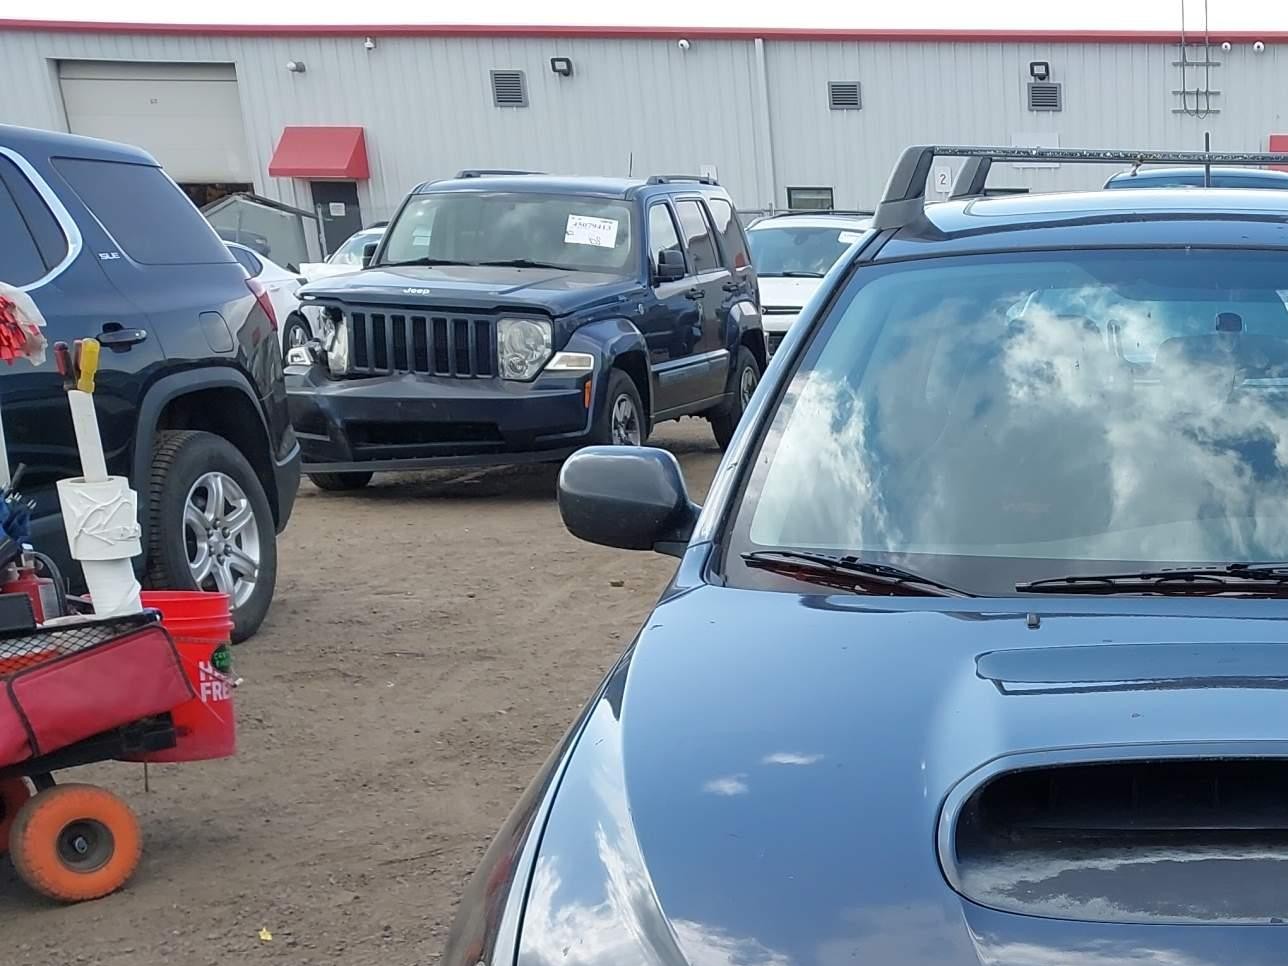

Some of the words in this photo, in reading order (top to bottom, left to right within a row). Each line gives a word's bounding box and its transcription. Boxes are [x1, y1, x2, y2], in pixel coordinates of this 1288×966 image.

[940, 173, 947, 185] 2
[98, 252, 121, 260] SLE
[403, 287, 431, 296] Jeep
